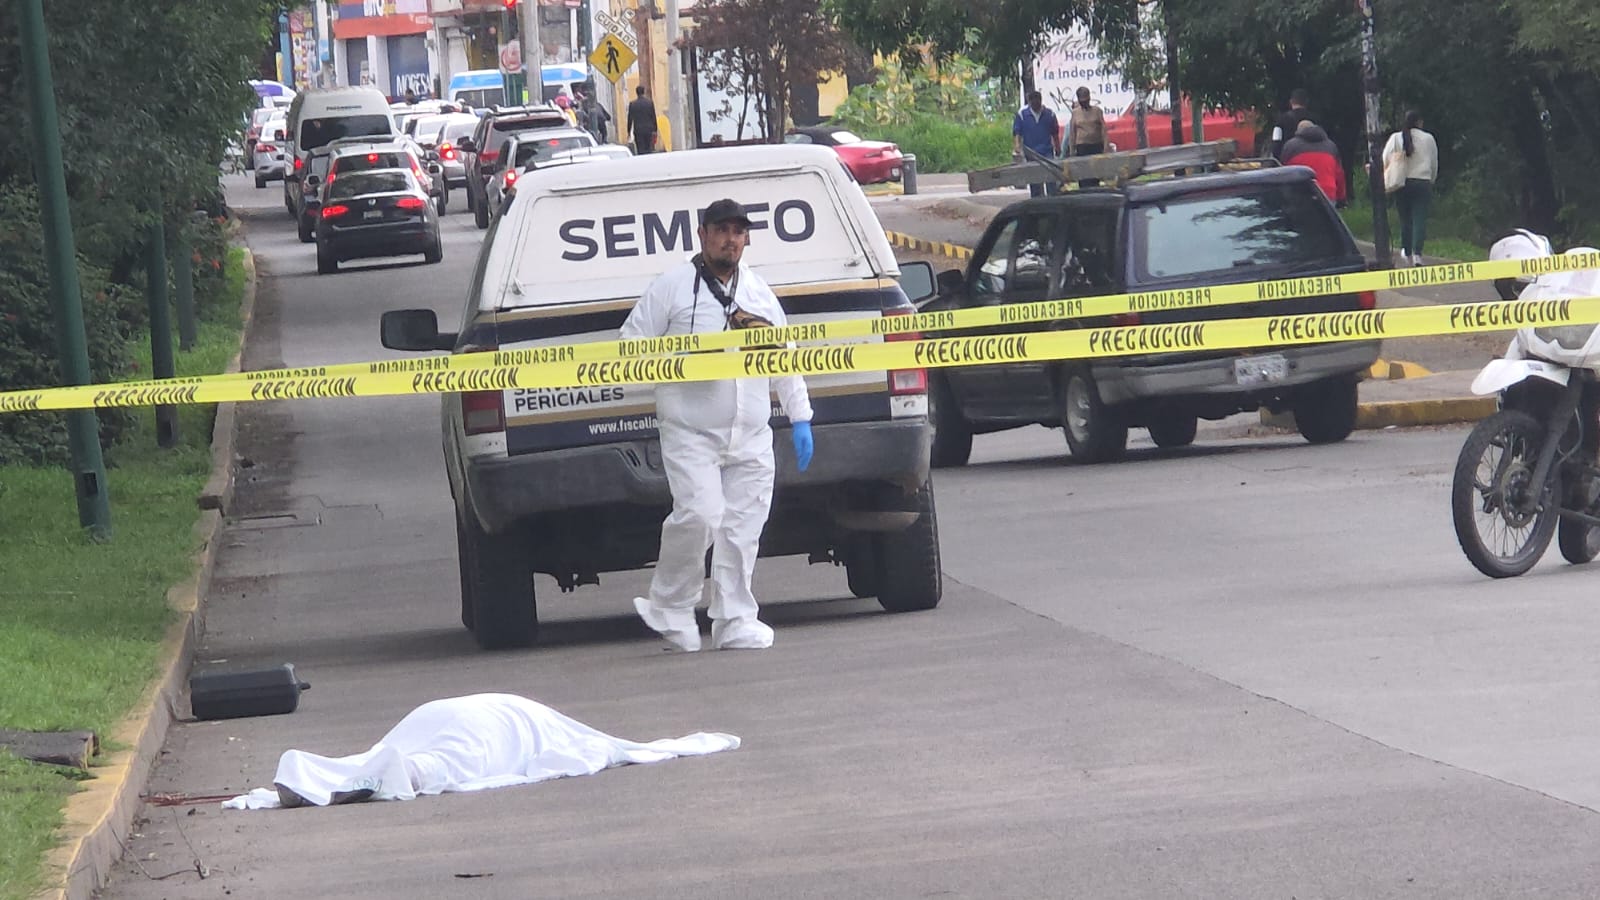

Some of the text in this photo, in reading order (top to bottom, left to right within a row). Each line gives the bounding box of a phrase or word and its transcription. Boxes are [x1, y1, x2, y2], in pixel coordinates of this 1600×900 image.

[597, 13, 637, 47] CUIDADO
[1044, 70, 1054, 80] la
[559, 199, 816, 261] SEMFO
[251, 376, 357, 400] PRECAUCION
[412, 367, 519, 393] PRECAUCION
[577, 357, 686, 385] PRECAUCION
[744, 347, 854, 375] PRECAUCION
[915, 336, 1028, 364] PRECAUCION
[1090, 324, 1205, 352] PRECAUCION
[1268, 312, 1386, 341] PRECAUCION
[1450, 300, 1570, 328] PRECAUCION
[515, 387, 624, 413] PERICIALES
